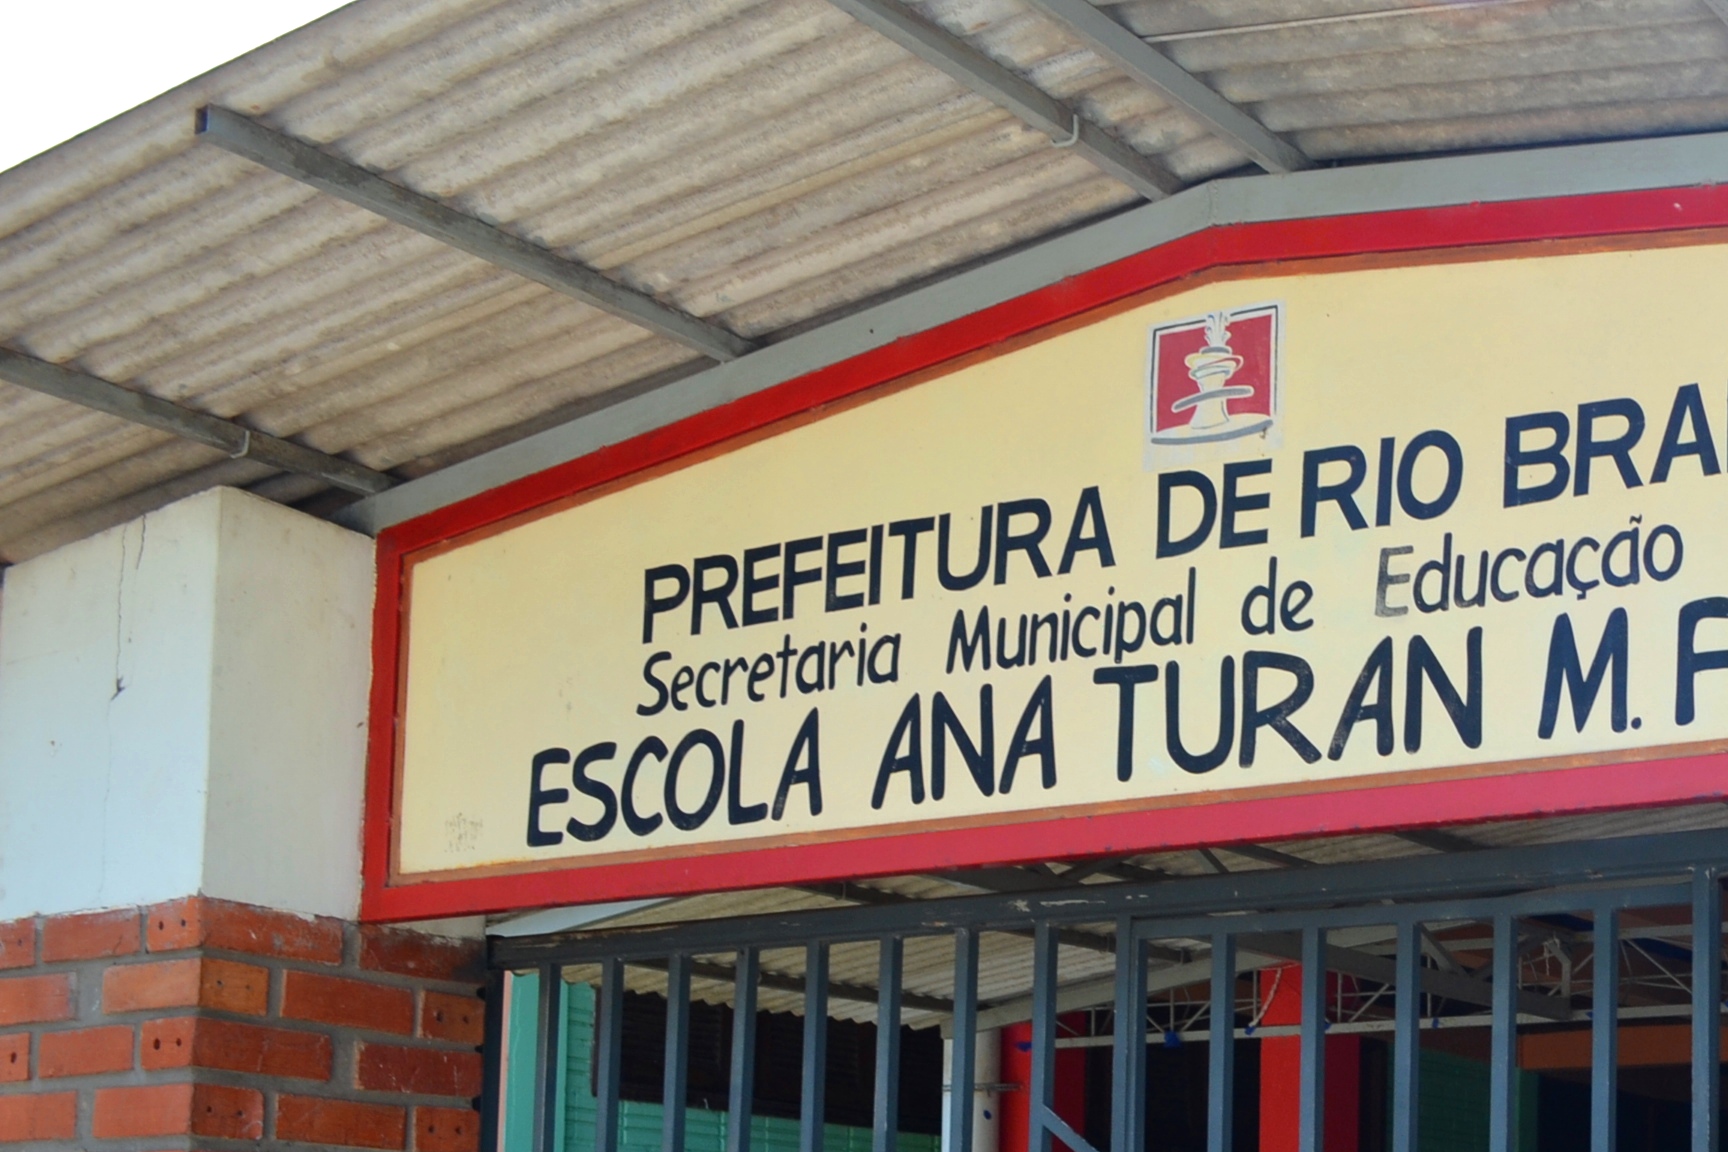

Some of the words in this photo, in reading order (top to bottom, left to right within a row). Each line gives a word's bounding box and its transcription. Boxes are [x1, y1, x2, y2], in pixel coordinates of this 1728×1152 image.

[635, 622, 902, 717] Secretaria
[945, 566, 1197, 675] Municipal
[1241, 556, 1314, 637] de
[1374, 513, 1685, 618] Educação
[642, 485, 1117, 644] PREFEITURA
[1155, 458, 1274, 560] DE
[1300, 429, 1465, 539] RIO
[526, 706, 824, 848] ESCOLA
[870, 674, 1058, 811] ANA
[1092, 625, 1484, 783] TURAN
[1537, 606, 1643, 741] M.
